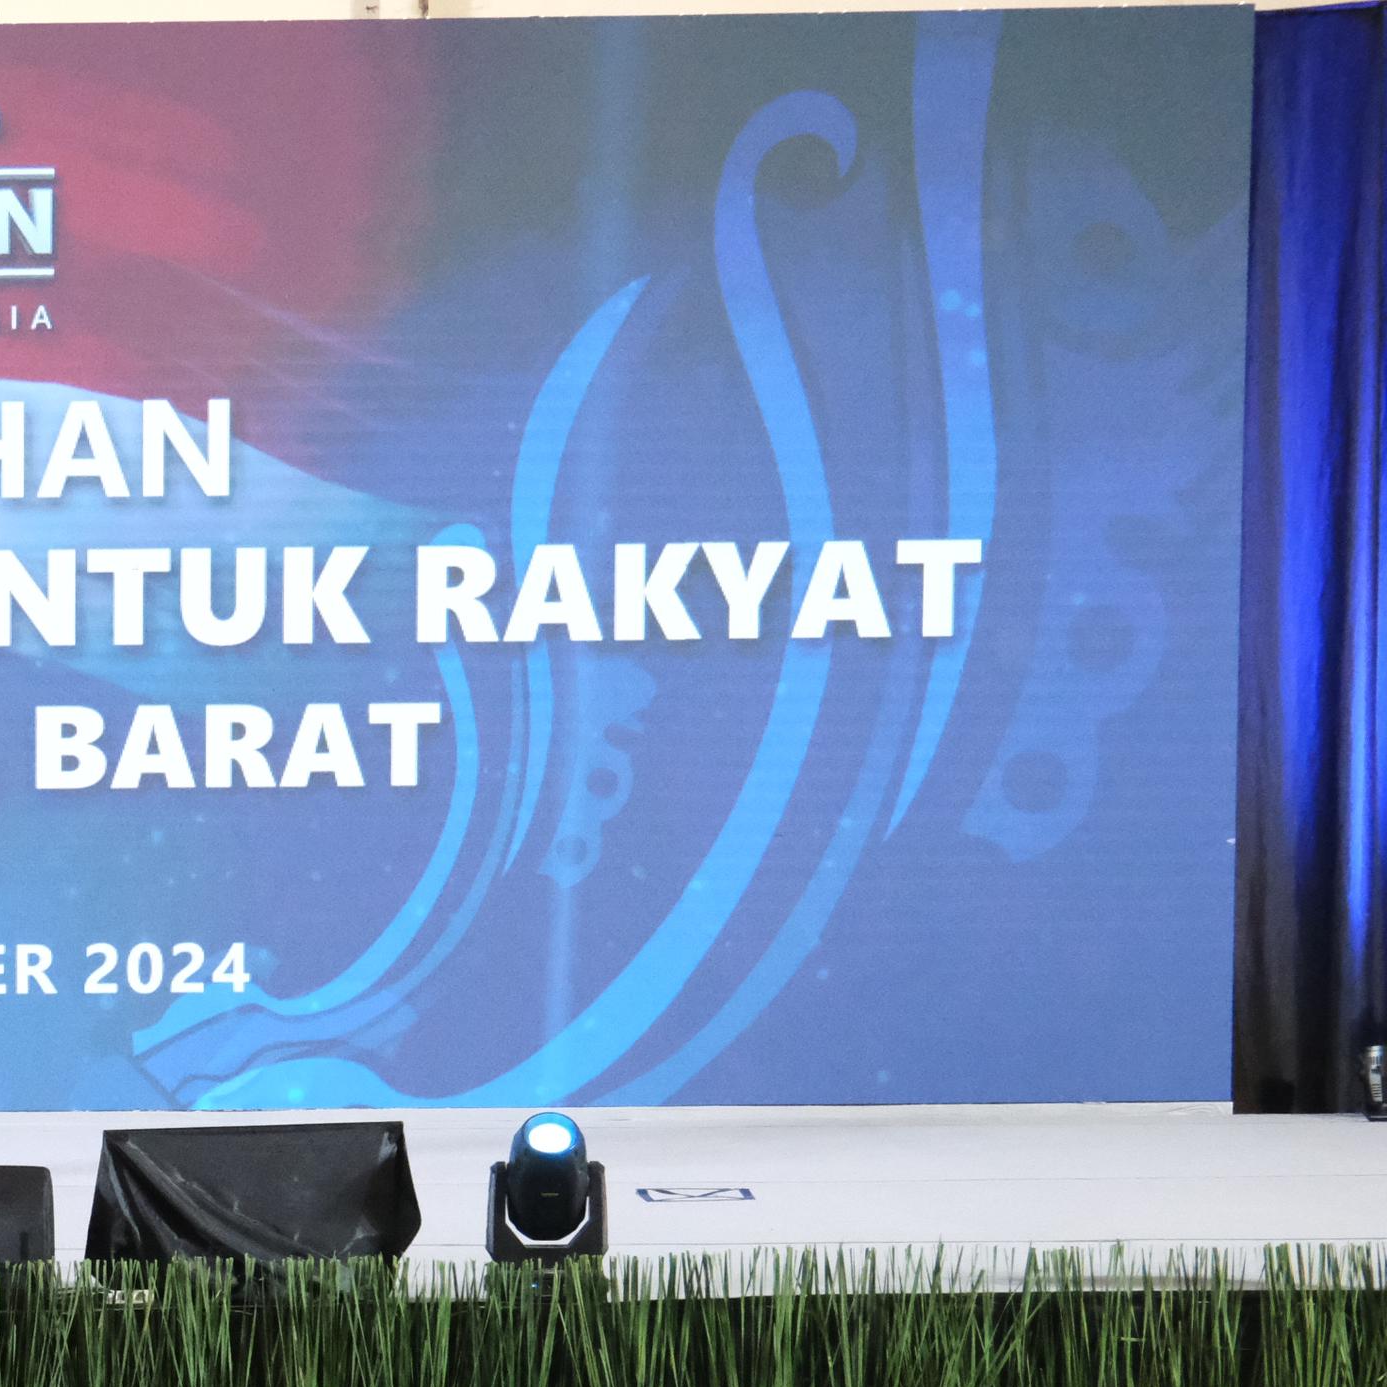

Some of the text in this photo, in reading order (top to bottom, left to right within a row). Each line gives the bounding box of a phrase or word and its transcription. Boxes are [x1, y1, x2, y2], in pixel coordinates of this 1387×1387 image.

[417, 541, 980, 642] RAKYAT
[36, 703, 440, 789] BARAT
[84, 942, 250, 994] 2024
